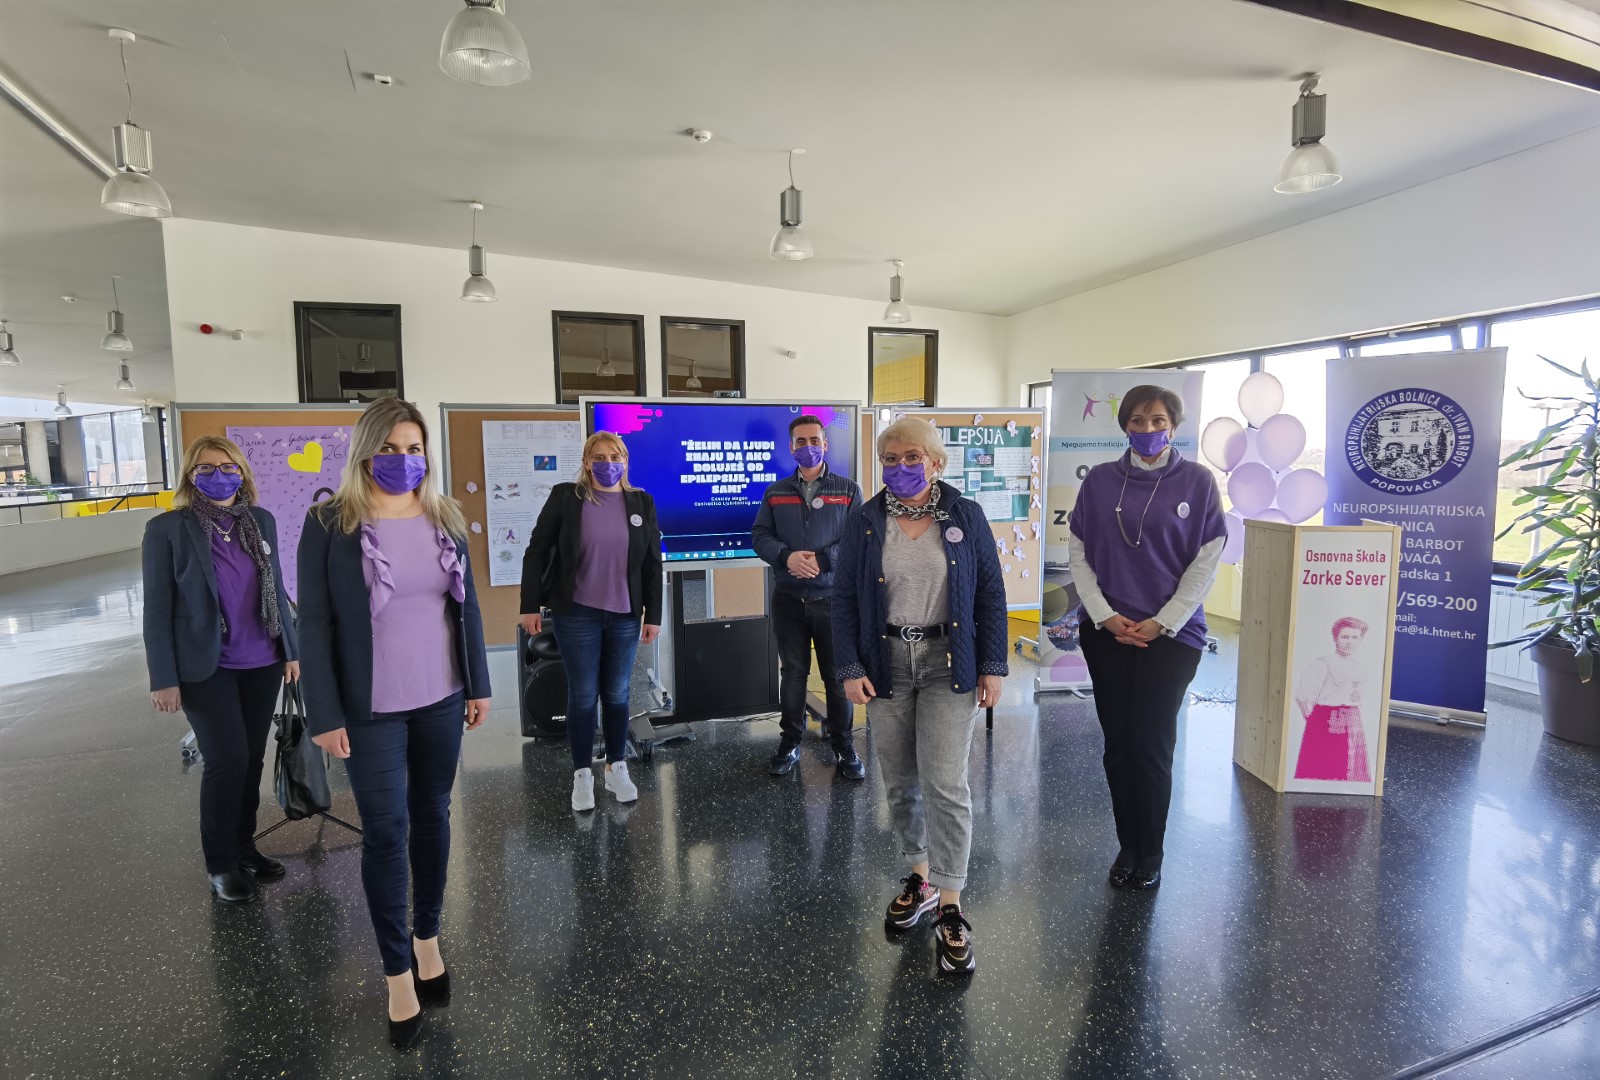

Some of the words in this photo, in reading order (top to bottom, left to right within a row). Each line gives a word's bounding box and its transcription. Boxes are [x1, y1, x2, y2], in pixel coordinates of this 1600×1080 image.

[1399, 391, 1440, 406] BOLNICA
[1442, 404, 1455, 417] dr.
[1451, 413, 1470, 433] IVAN
[1347, 394, 1397, 471] NEUROPSIHIJATRIJSKA
[723, 441, 741, 450] DA
[743, 441, 775, 450] LJUDI
[1061, 441, 1097, 449] Njegujemo
[1098, 440, 1124, 448] tradiciju
[1451, 434, 1471, 468] BARBOT
[685, 452, 723, 462] ZNAJU
[726, 452, 743, 461] DA
[745, 452, 771, 461] AKO
[693, 461, 744, 472] BOLUJEŠ
[746, 462, 764, 472] OD
[680, 473, 750, 483] EPILEPSIJE,
[752, 473, 777, 482] NISI
[1370, 478, 1441, 493] POPOVAČA
[1333, 502, 1485, 517] NEUROPSIHIJATRIJSKA
[1405, 537, 1464, 551] BARBOT
[1306, 549, 1353, 562] Osnovna
[1355, 549, 1386, 563] škola
[1302, 569, 1342, 585] Zorke
[1345, 570, 1386, 586] Sever
[1444, 571, 1452, 582] 1
[1397, 591, 1477, 611] /569-200
[1394, 624, 1476, 640] ca@sk.htnet.hr
